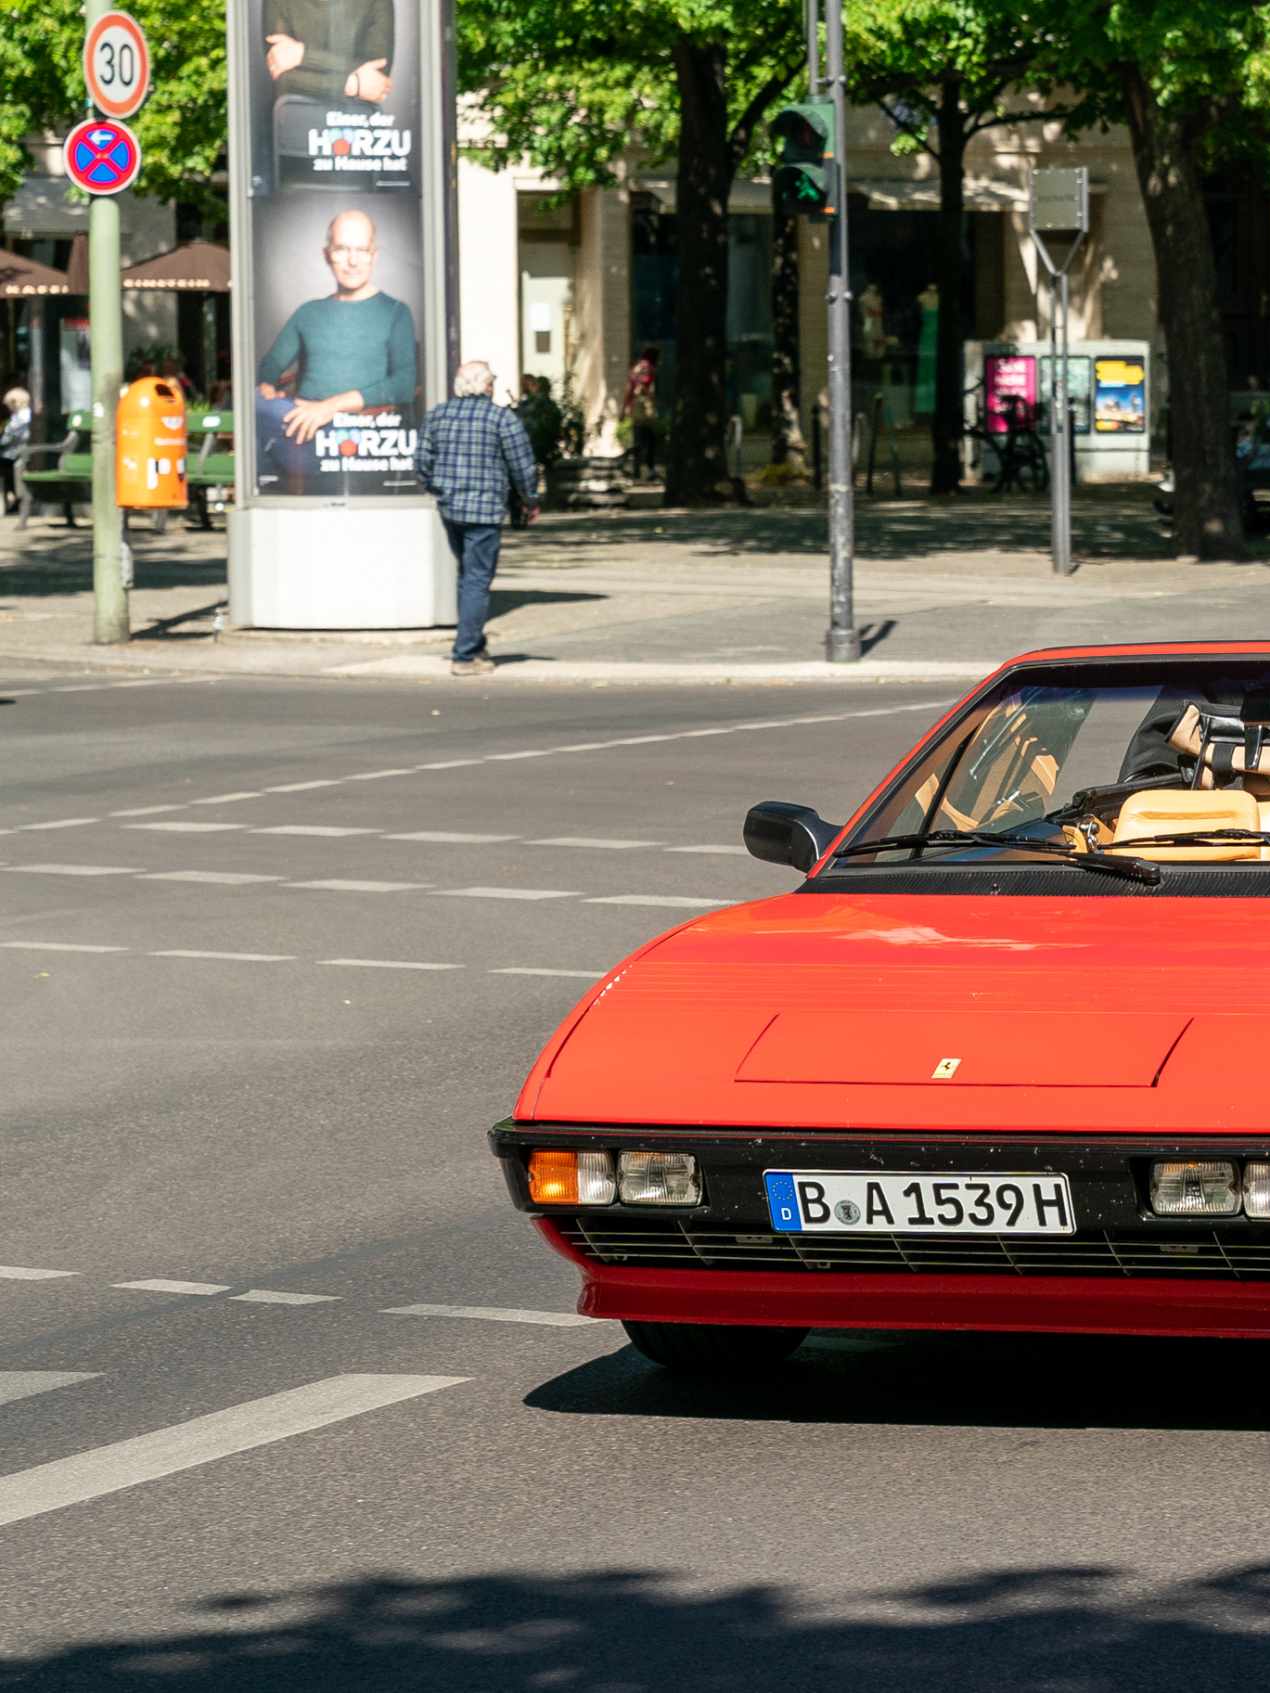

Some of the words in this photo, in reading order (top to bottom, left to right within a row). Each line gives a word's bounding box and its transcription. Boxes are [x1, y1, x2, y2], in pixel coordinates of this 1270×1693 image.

[100, 42, 134, 86] 30
[369, 111, 395, 127] der
[313, 158, 333, 171] zu
[334, 156, 382, 171] Hause
[383, 156, 408, 171] hat
[375, 411, 402, 428] der
[320, 459, 340, 472] zu
[341, 456, 389, 472] Hause
[389, 456, 414, 471] hat
[797, 1181, 831, 1224] B
[781, 1207, 792, 1221] D
